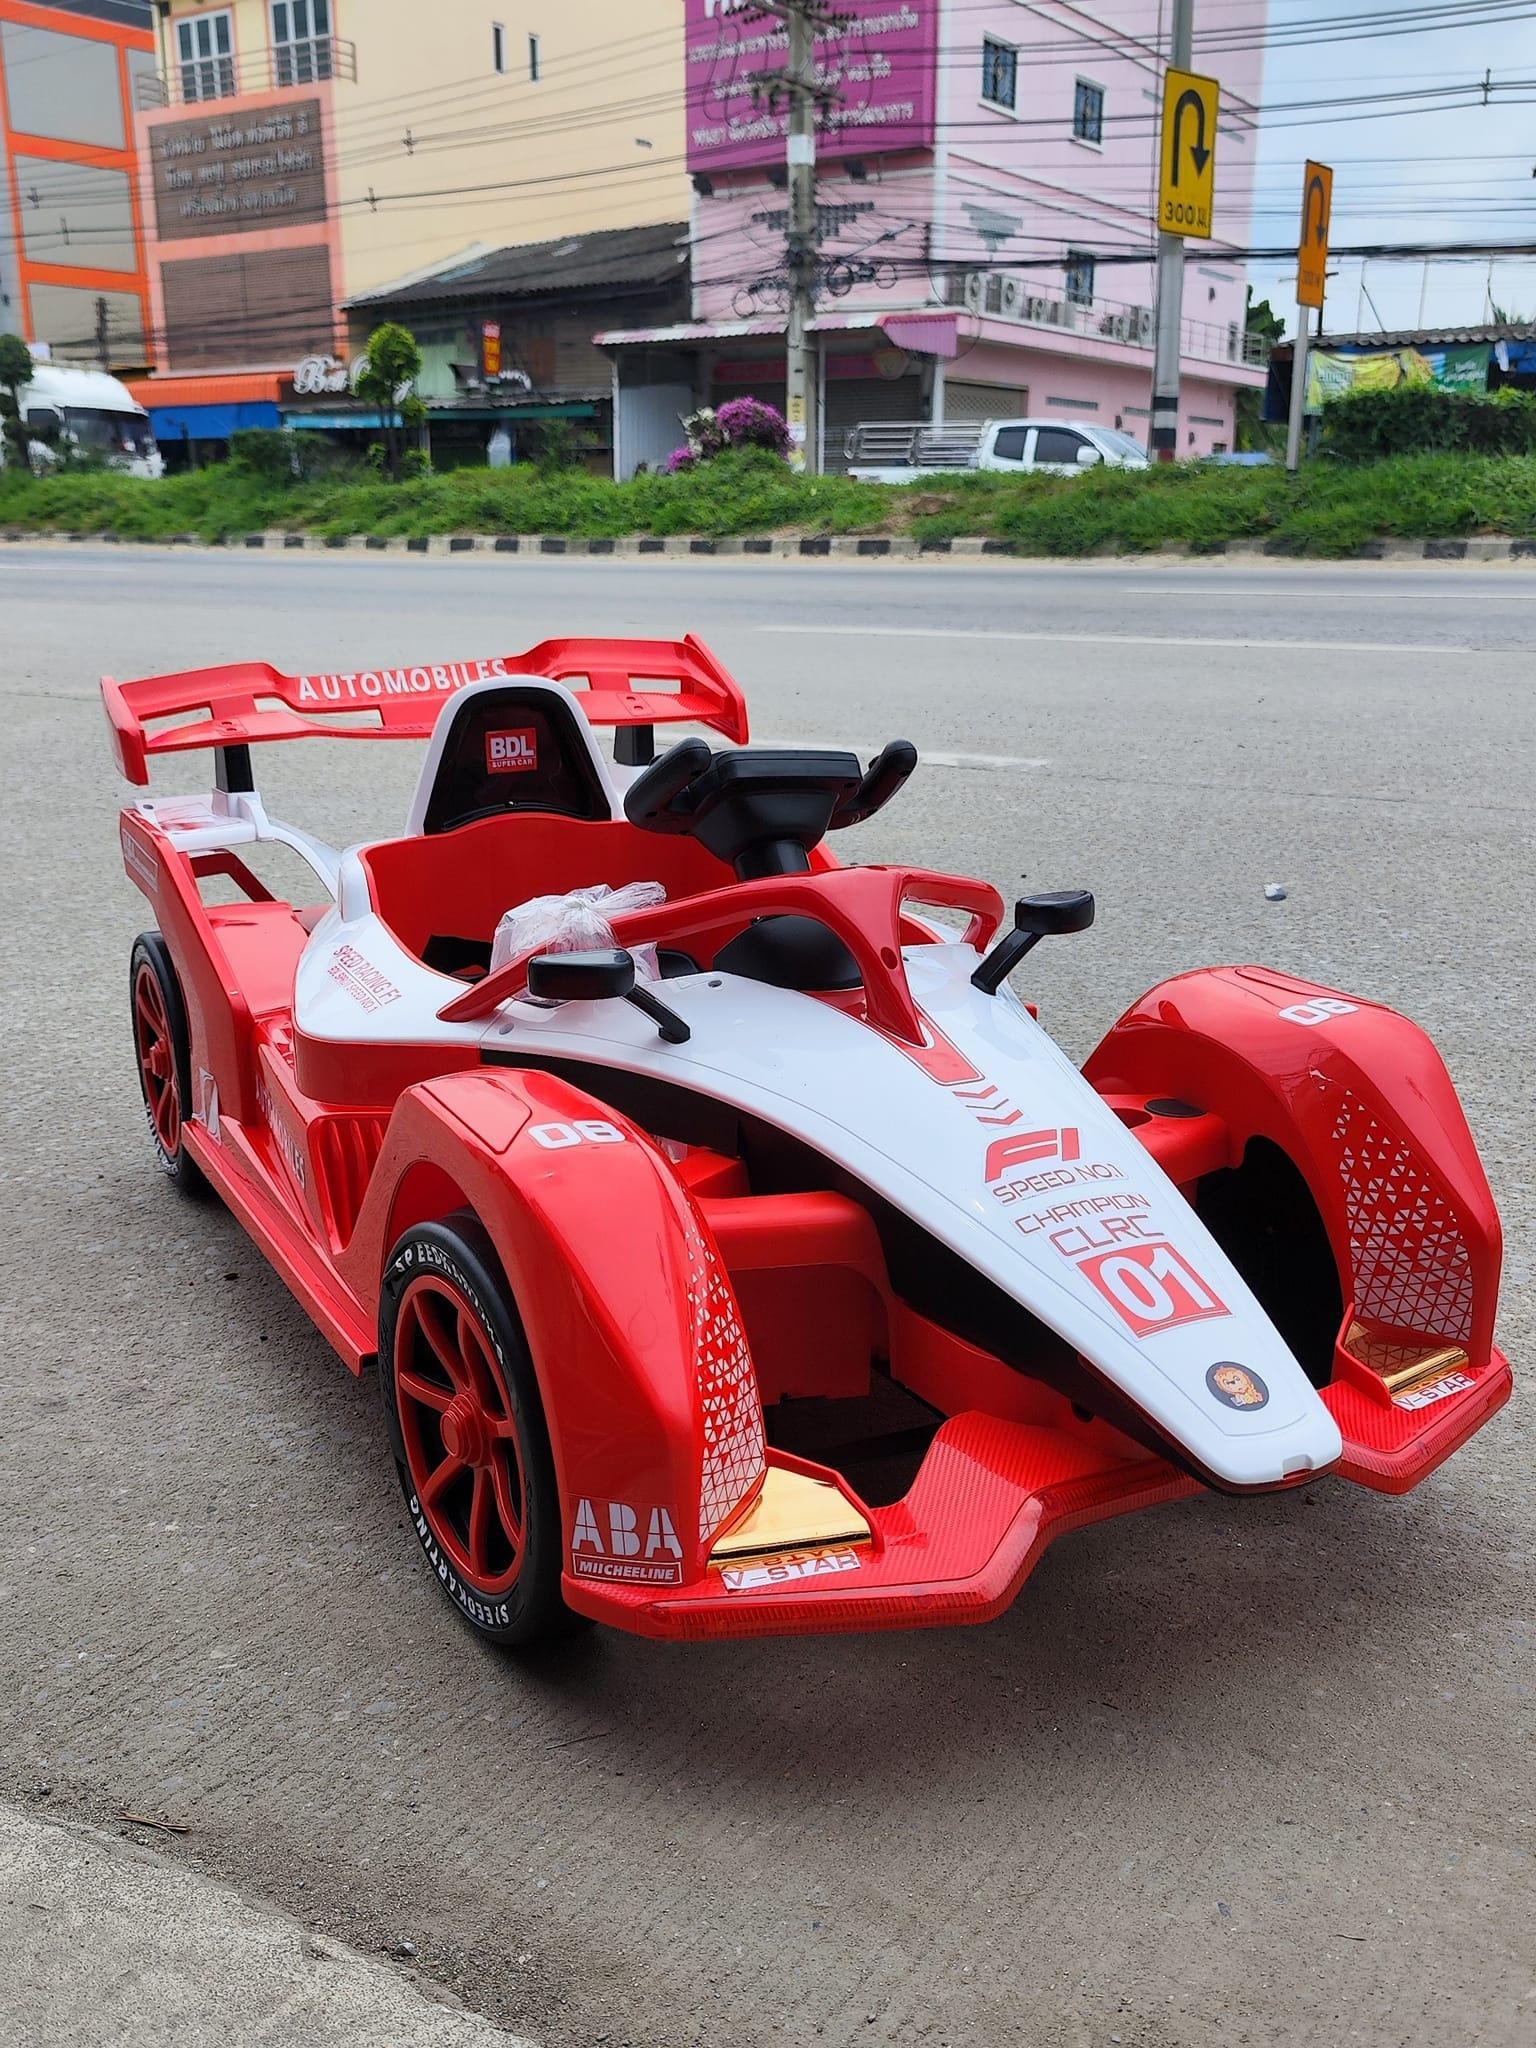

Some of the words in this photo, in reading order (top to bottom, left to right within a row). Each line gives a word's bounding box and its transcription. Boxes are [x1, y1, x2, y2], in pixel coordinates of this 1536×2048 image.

[1165, 201, 1194, 225] 300
[299, 659, 507, 701] AUTOMOBILES
[490, 735, 535, 759] BDL
[333, 945, 365, 969] SPEED
[992, 1169, 1077, 1204] SPEED
[1014, 1193, 1152, 1234] CHAMPION
[1048, 1214, 1165, 1257] CLRC
[1099, 1246, 1217, 1322] 01
[1396, 1374, 1473, 1408] V-STAR
[571, 1499, 683, 1558] ABA
[722, 1554, 858, 1587] V-STAR
